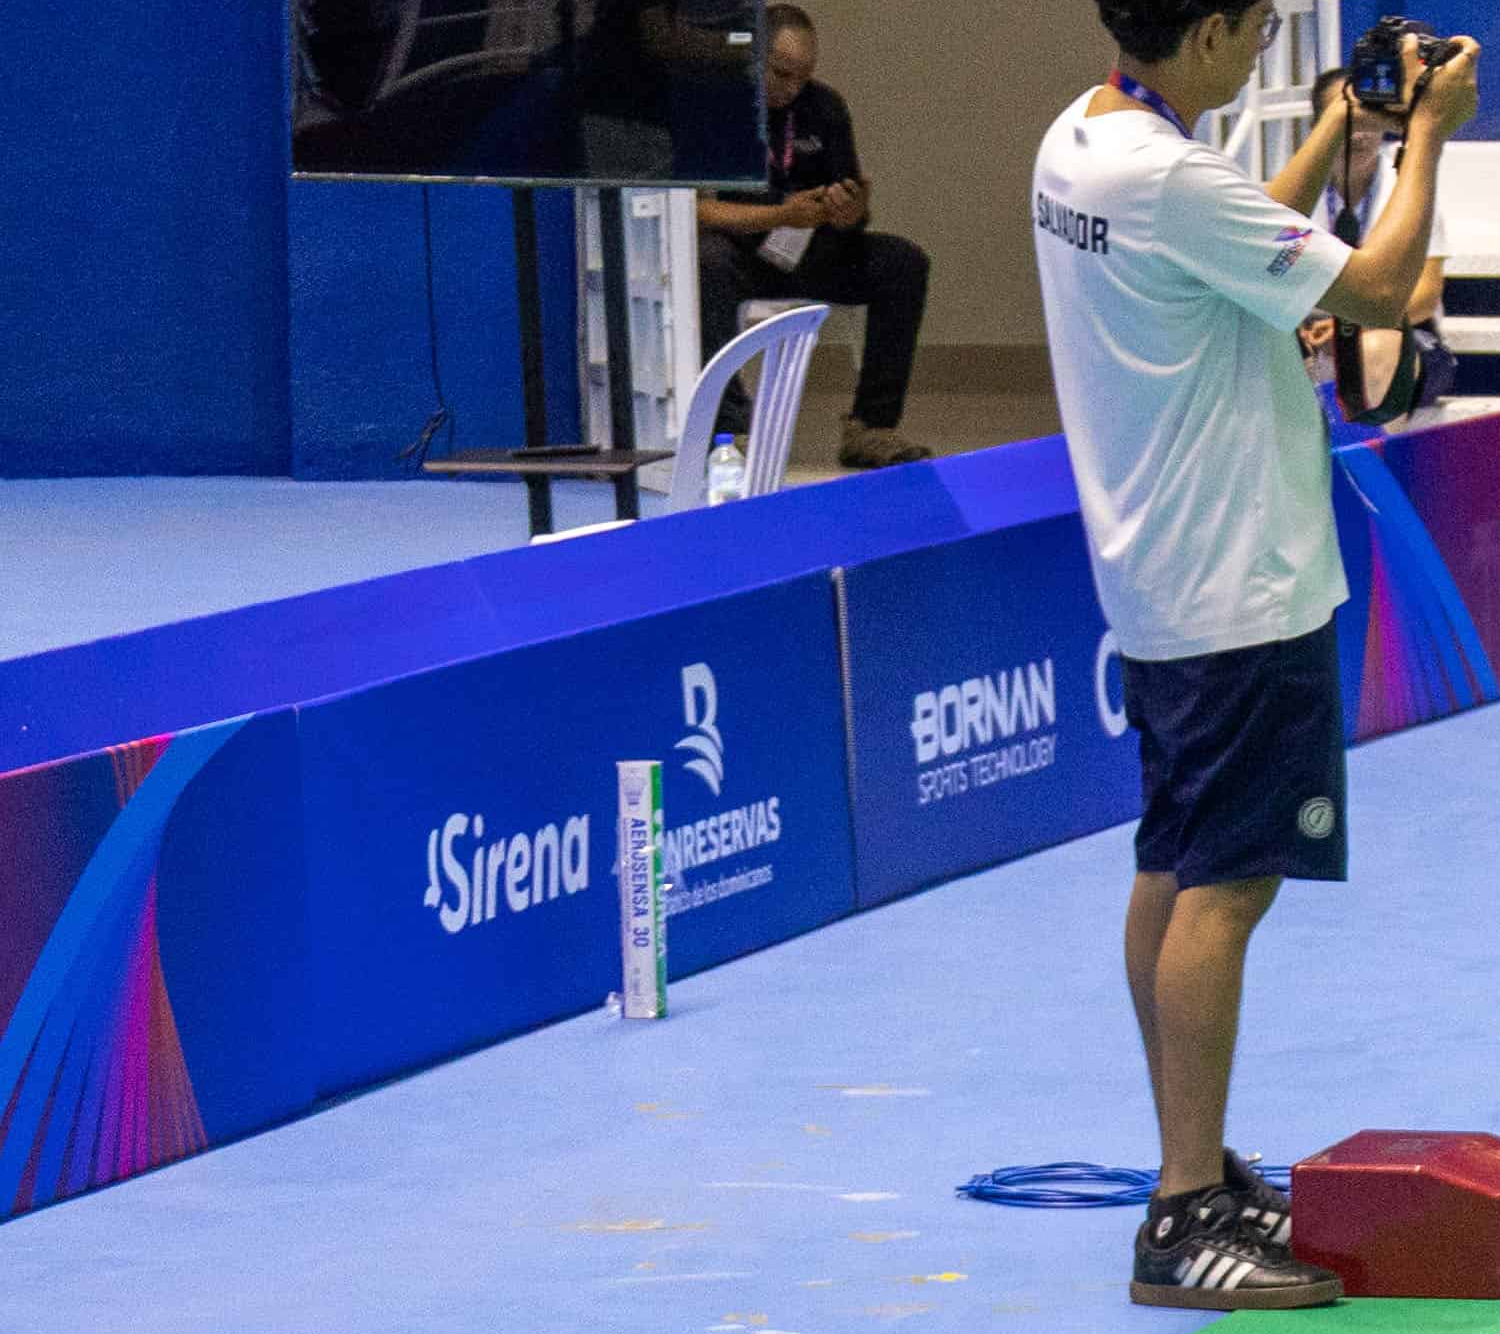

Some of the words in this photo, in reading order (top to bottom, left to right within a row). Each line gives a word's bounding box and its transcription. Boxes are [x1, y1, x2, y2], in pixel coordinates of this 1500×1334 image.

[910, 658, 1057, 764] BORNAN
[437, 811, 590, 934] Sirena
[660, 795, 782, 873] NRESERVAS
[632, 926, 650, 949] 30
